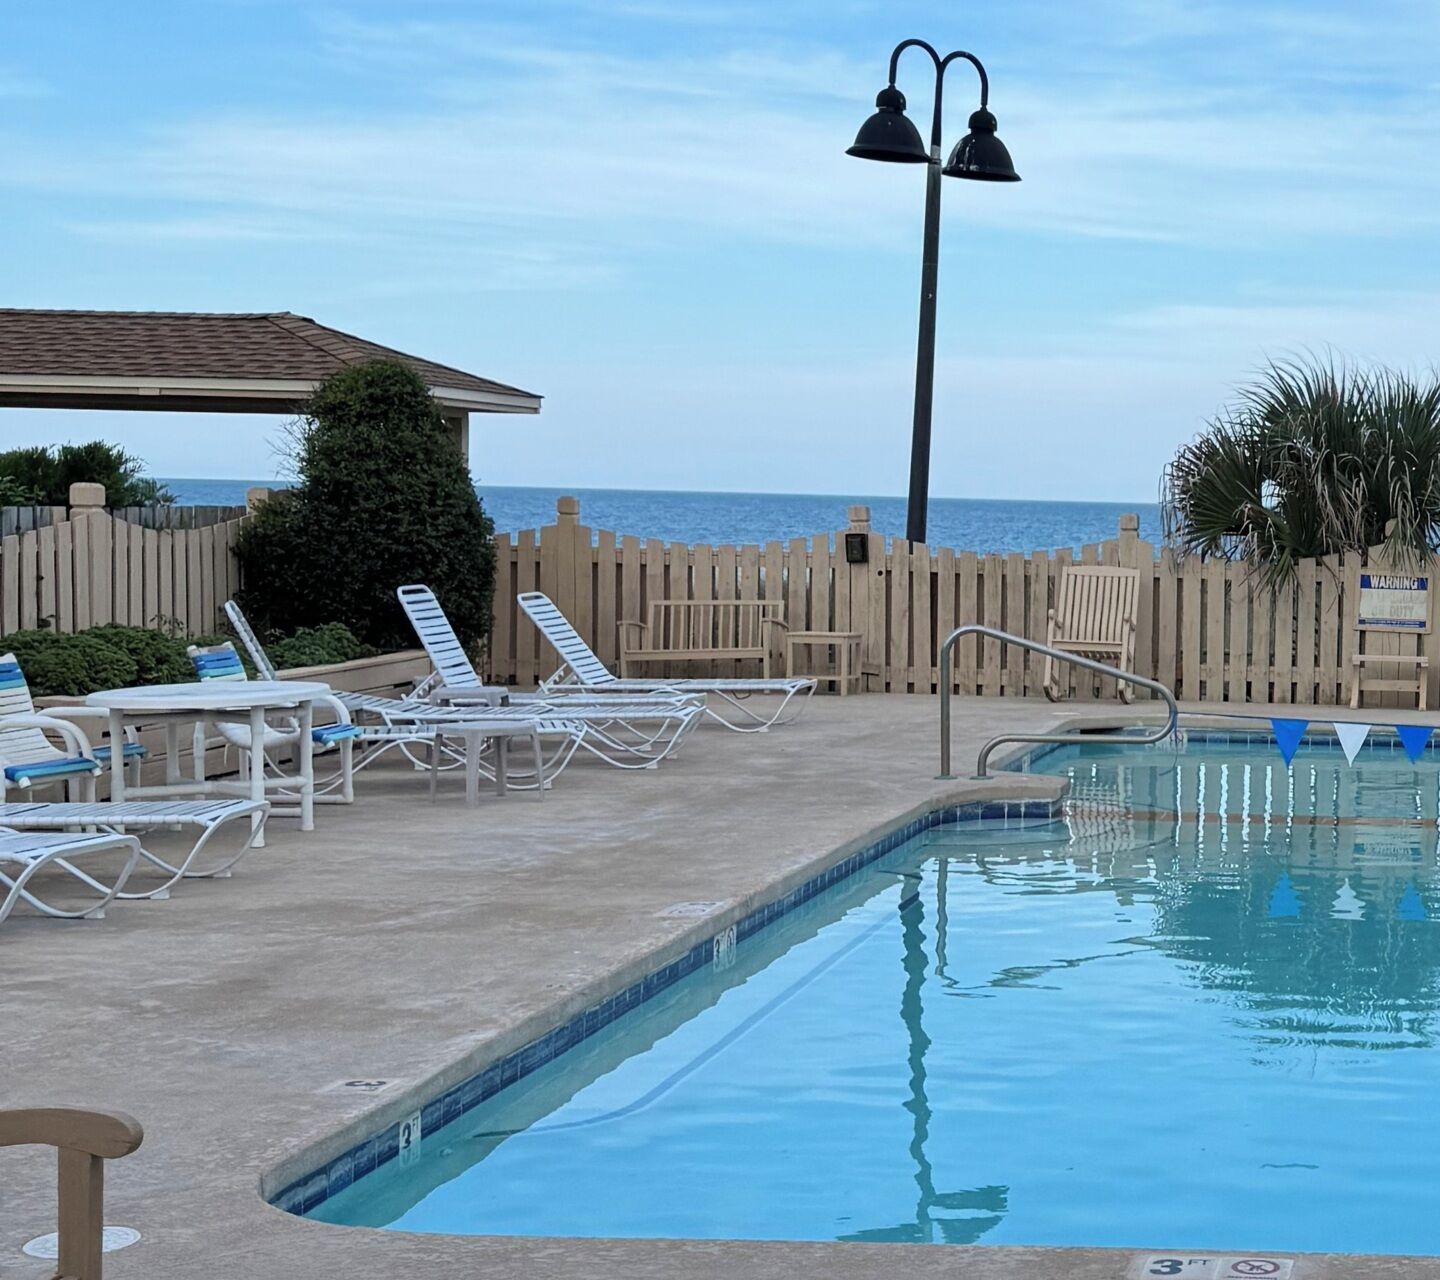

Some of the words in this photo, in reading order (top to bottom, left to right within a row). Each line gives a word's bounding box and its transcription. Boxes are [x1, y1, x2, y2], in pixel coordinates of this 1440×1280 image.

[1370, 575, 1418, 590] WARNING
[402, 1122, 412, 1150] 3
[1149, 1259, 1184, 1276] 3
